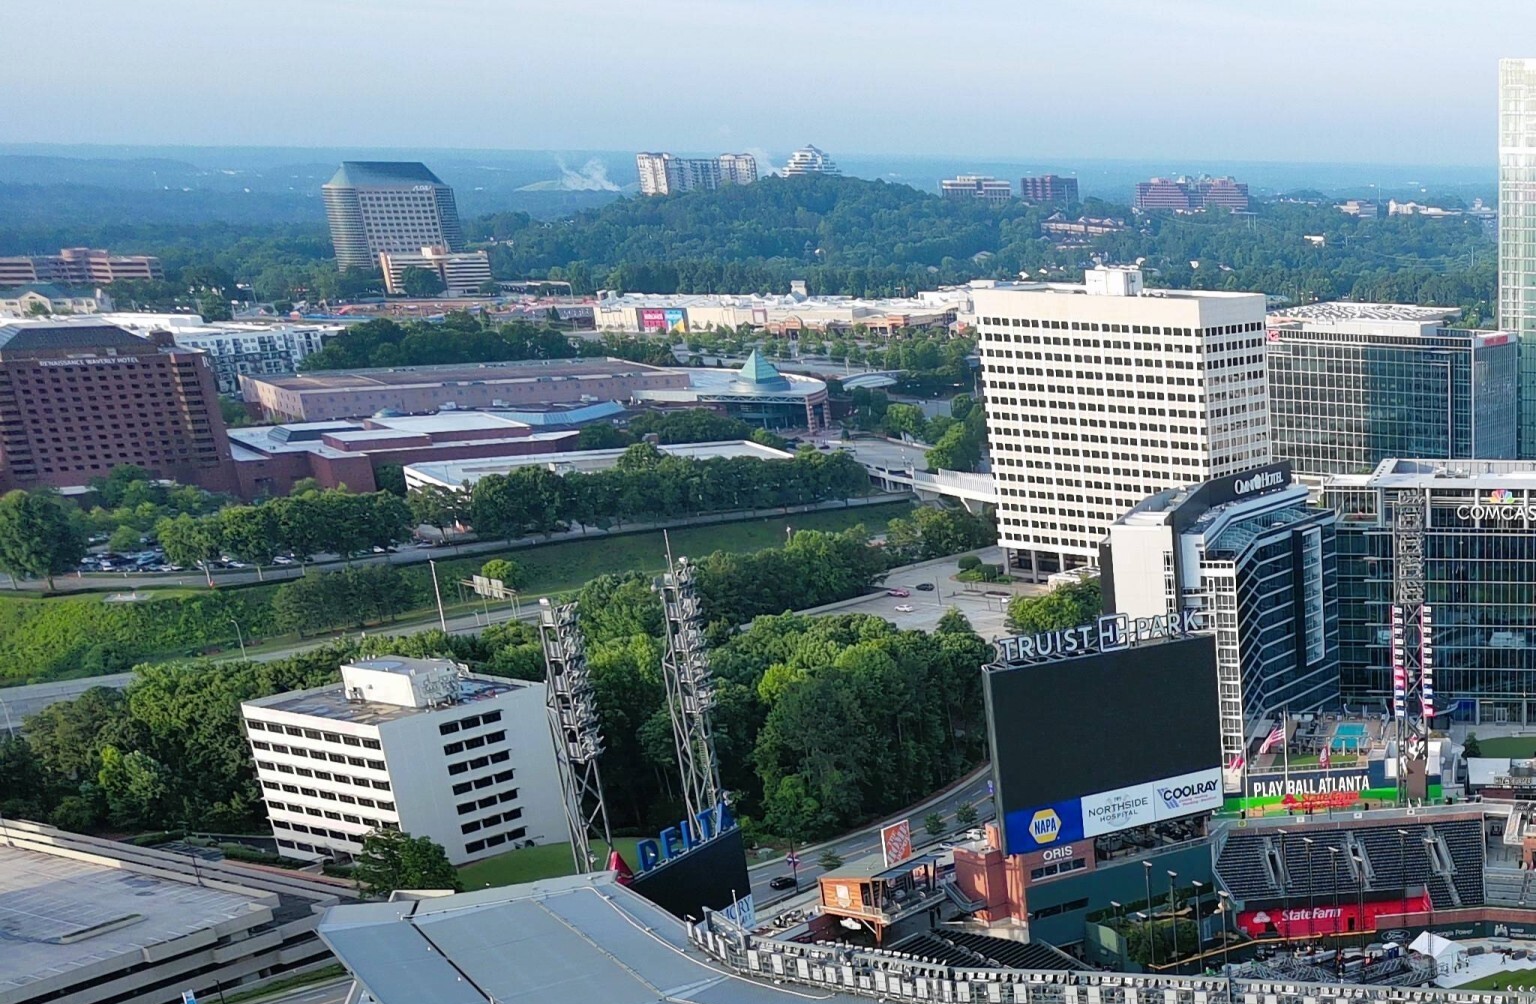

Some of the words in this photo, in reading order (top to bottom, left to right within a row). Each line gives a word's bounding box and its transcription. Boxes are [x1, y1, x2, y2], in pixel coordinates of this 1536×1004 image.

[39, 359, 84, 367] RENAISSANCE
[85, 358, 116, 366] WAVERLY
[1000, 626, 1093, 661] TRUIST
[1136, 609, 1200, 641] PARK
[1163, 779, 1218, 801] COOLRAY
[1253, 781, 1285, 797] PLAY
[1286, 778, 1315, 795] BALL
[1316, 775, 1370, 793] ATLANTA
[1088, 797, 1149, 817] NORTHSIDE
[1099, 810, 1138, 822] HOSPITAL
[1034, 817, 1057, 834] NAPA
[637, 801, 734, 871] DELTA
[1043, 846, 1073, 861] ORIS
[1455, 928, 1473, 936] Power
